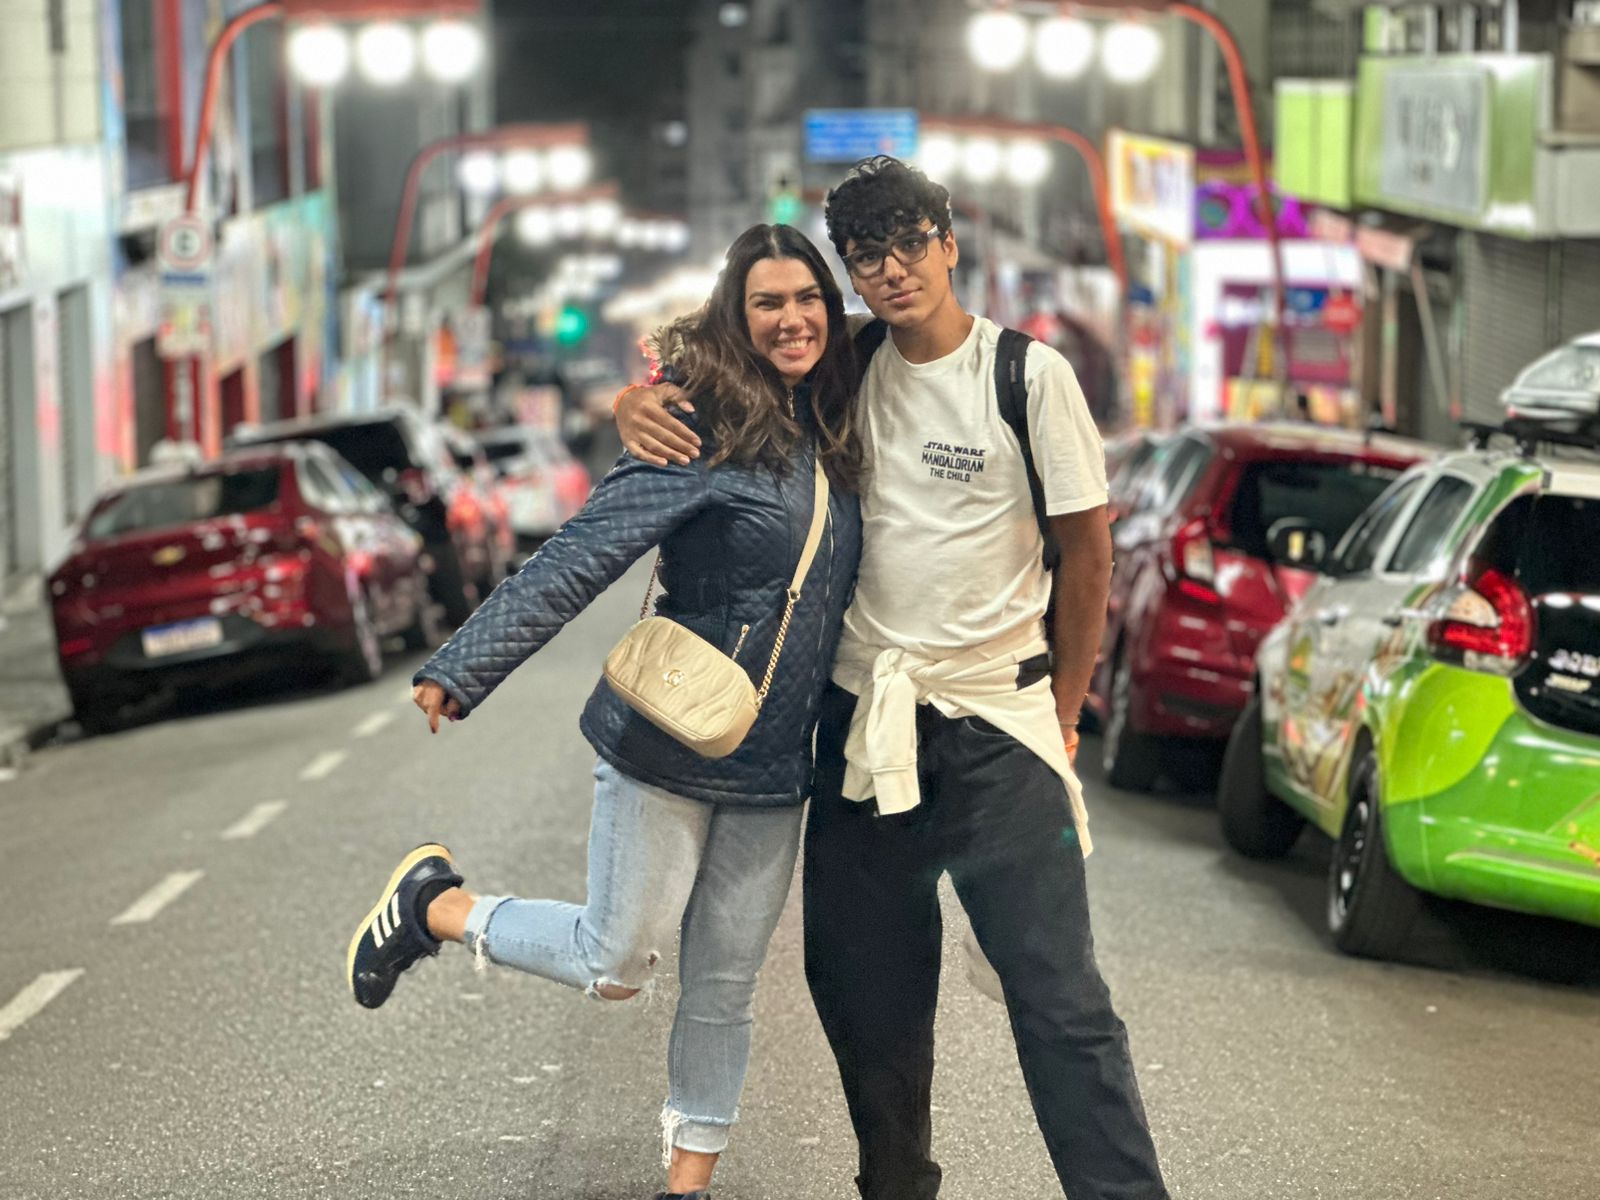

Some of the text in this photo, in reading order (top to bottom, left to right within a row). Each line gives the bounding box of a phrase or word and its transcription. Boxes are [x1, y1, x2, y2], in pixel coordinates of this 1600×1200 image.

[923, 441, 986, 457] STAR WARS
[921, 451, 984, 472] MANDALORIAN
[930, 467, 971, 482] THE CHILD
